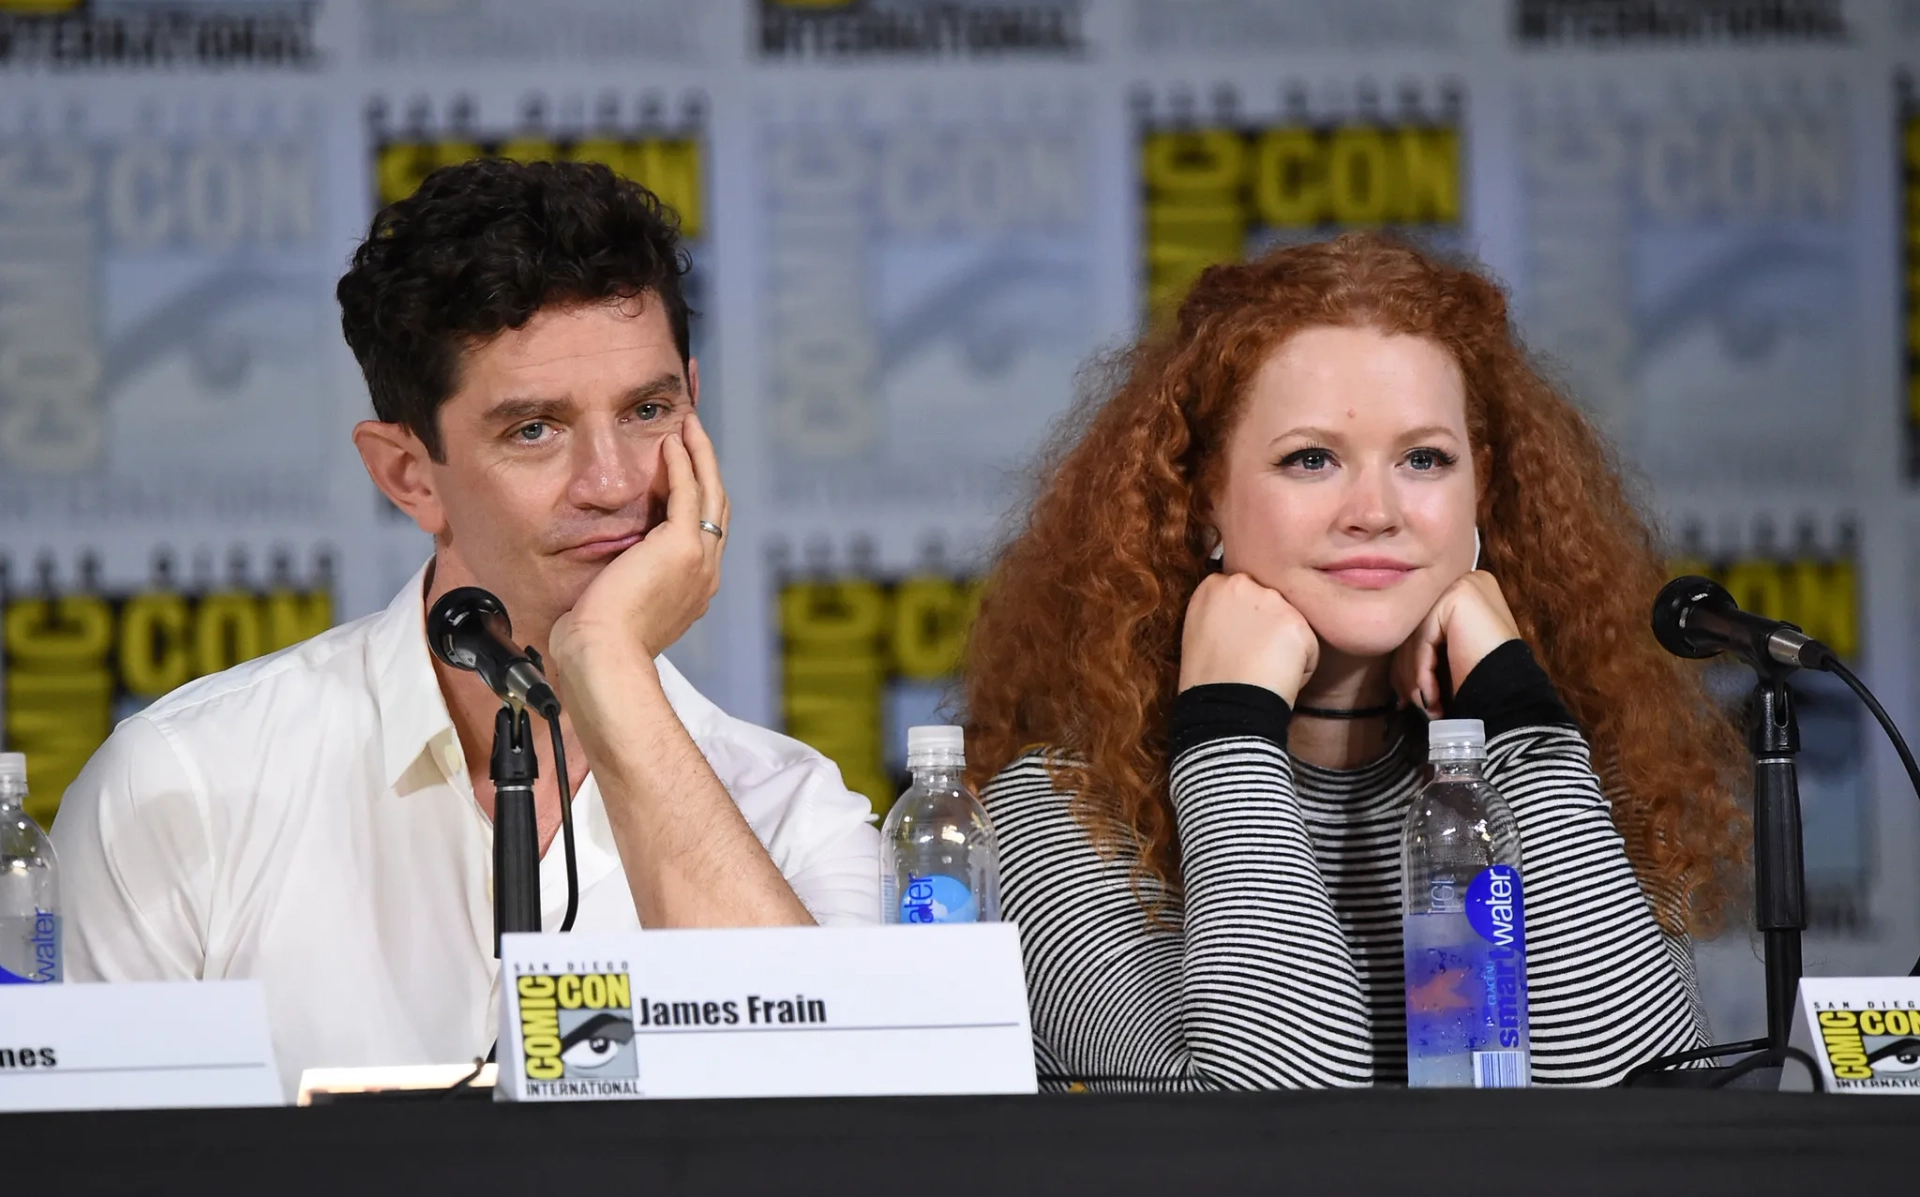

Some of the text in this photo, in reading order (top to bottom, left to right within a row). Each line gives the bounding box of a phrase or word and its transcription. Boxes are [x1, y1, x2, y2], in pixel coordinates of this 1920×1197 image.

[109, 143, 314, 244] CON
[1257, 127, 1463, 227] CON
[31, 906, 55, 983] water
[513, 961, 629, 972] SAN DIEGO
[557, 972, 632, 1010] CON
[639, 994, 827, 1027] James Frain
[1813, 1001, 1850, 1010] SAN
[517, 974, 564, 1080] COMIC
[1818, 1010, 1874, 1080] COMIC
[526, 1081, 641, 1096] INTERNATIONAL
